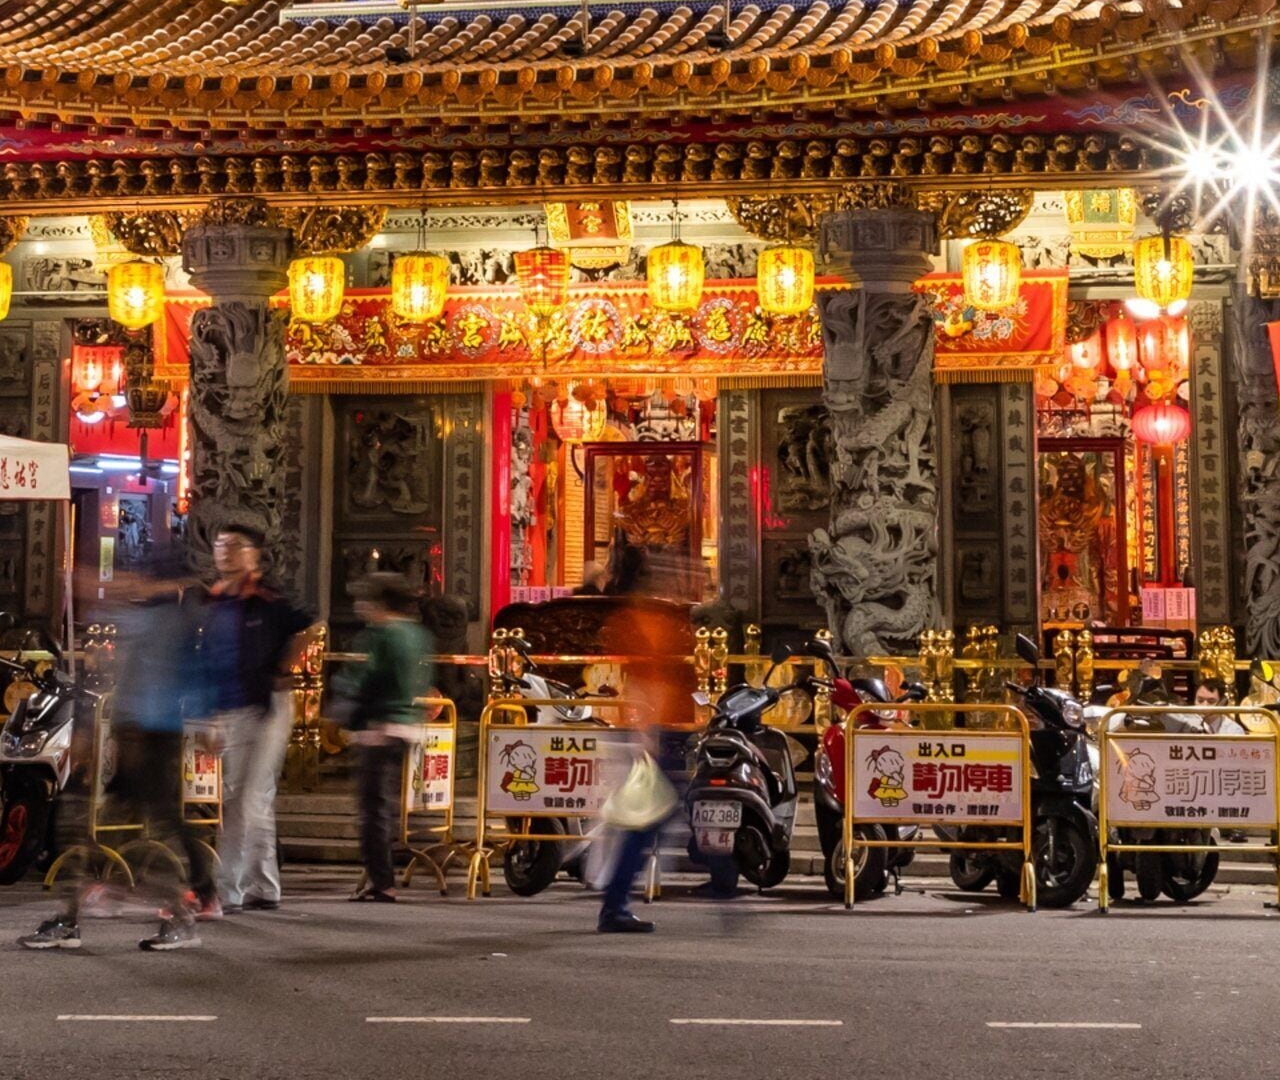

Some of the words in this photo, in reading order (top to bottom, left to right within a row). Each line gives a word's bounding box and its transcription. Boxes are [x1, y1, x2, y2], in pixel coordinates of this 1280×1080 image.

[550, 737, 596, 752] 出入口
[918, 742, 965, 757] 出入口
[1170, 745, 1216, 760] 出入口
[912, 762, 1013, 798] 請勿停車
[1165, 768, 1267, 802] 請勿停車
